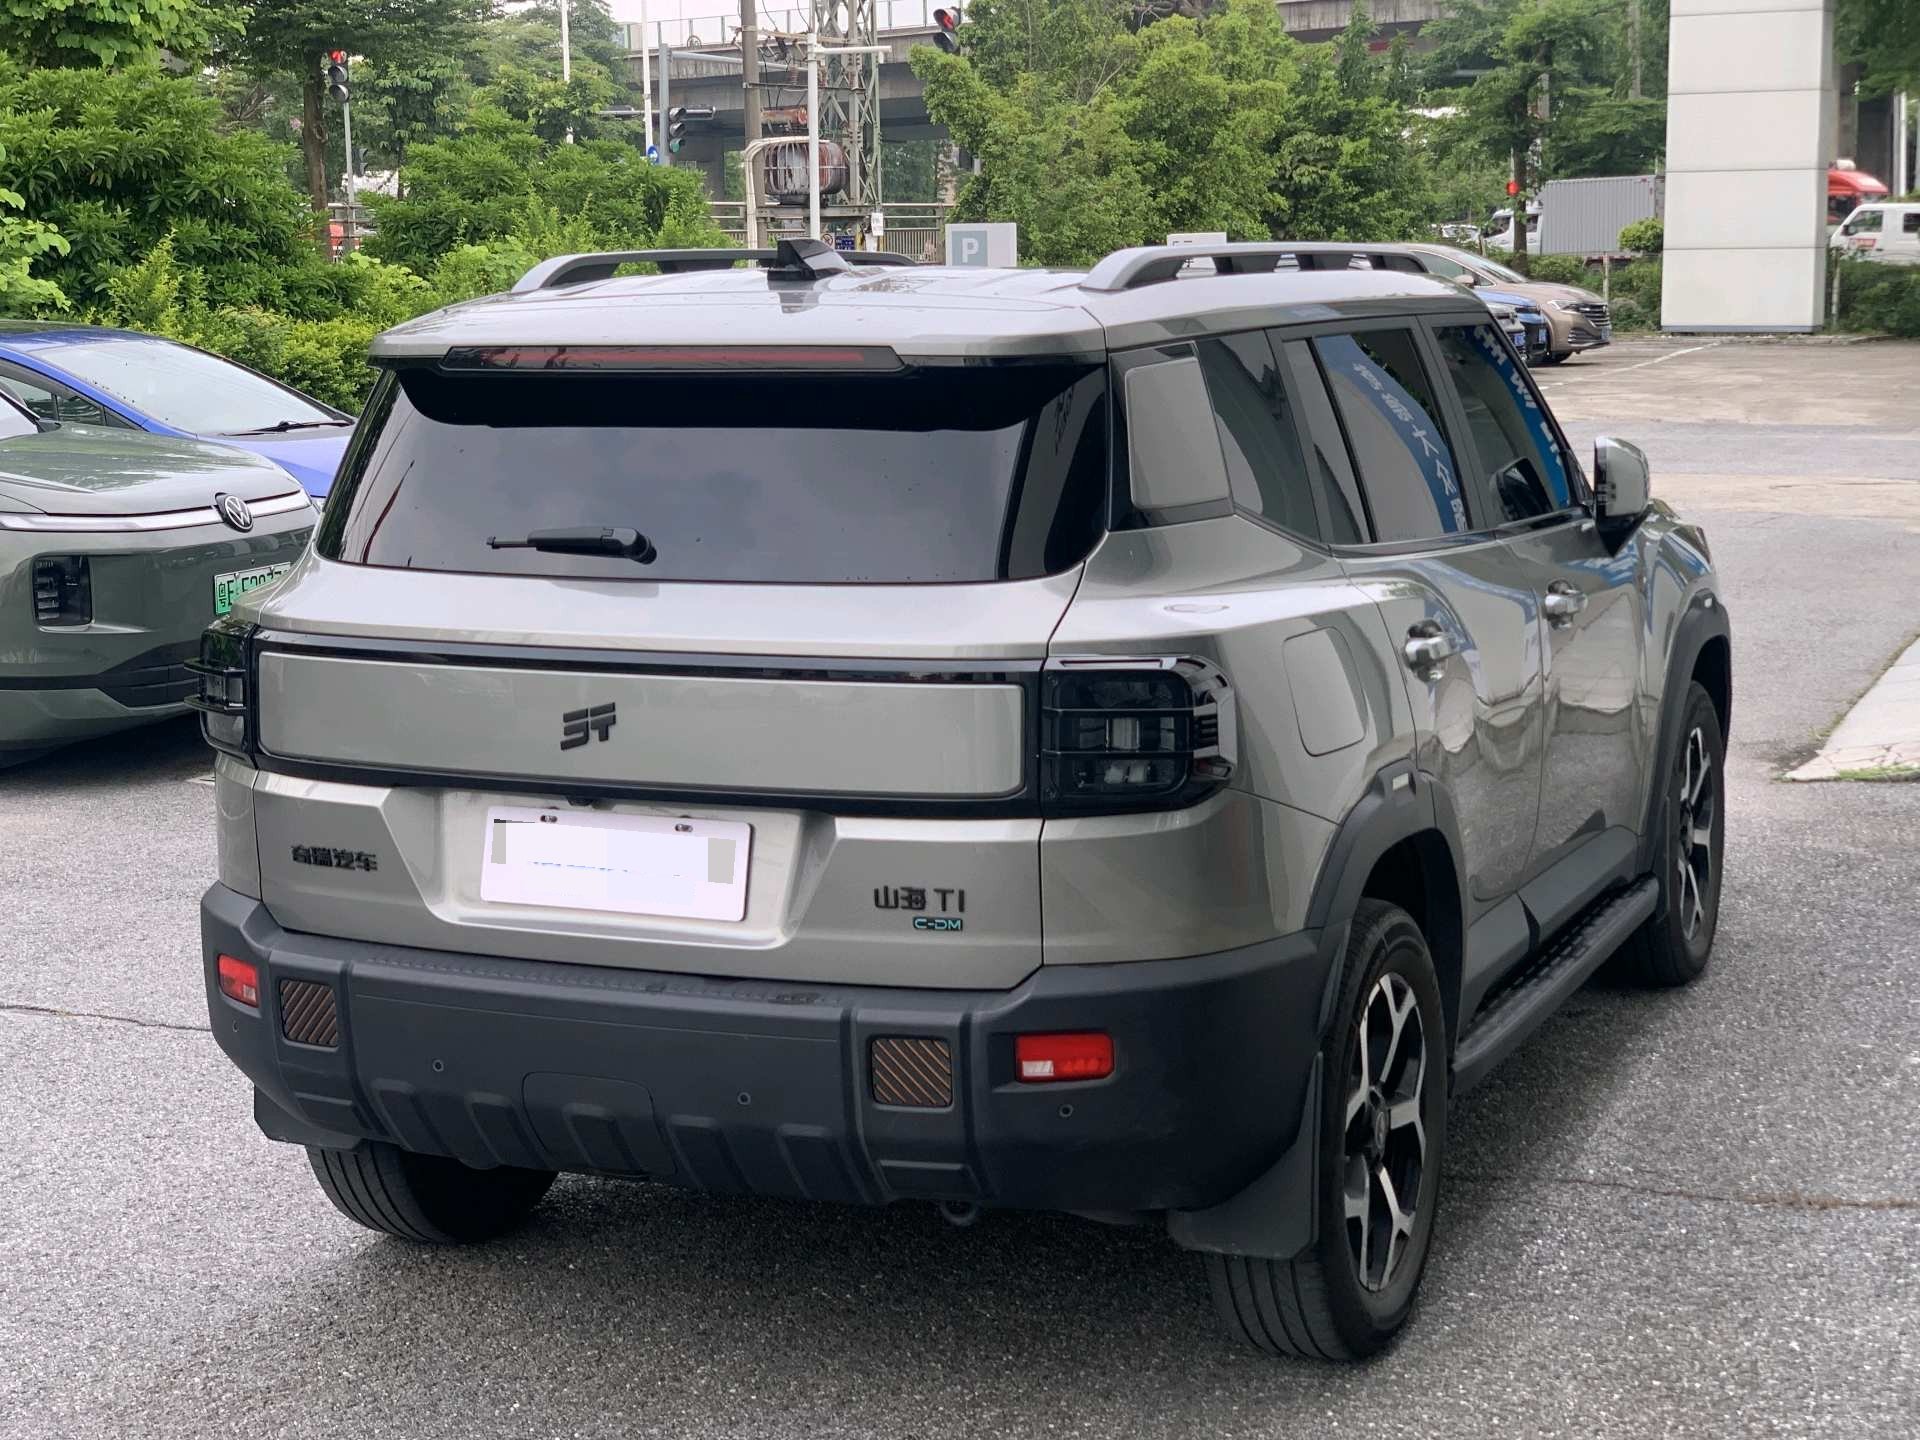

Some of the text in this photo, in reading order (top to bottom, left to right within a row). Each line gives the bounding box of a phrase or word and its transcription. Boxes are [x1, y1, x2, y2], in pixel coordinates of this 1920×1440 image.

[962, 237, 979, 264] P
[291, 844, 378, 872] 奇瑞汽车
[913, 917, 963, 931] C-DM
